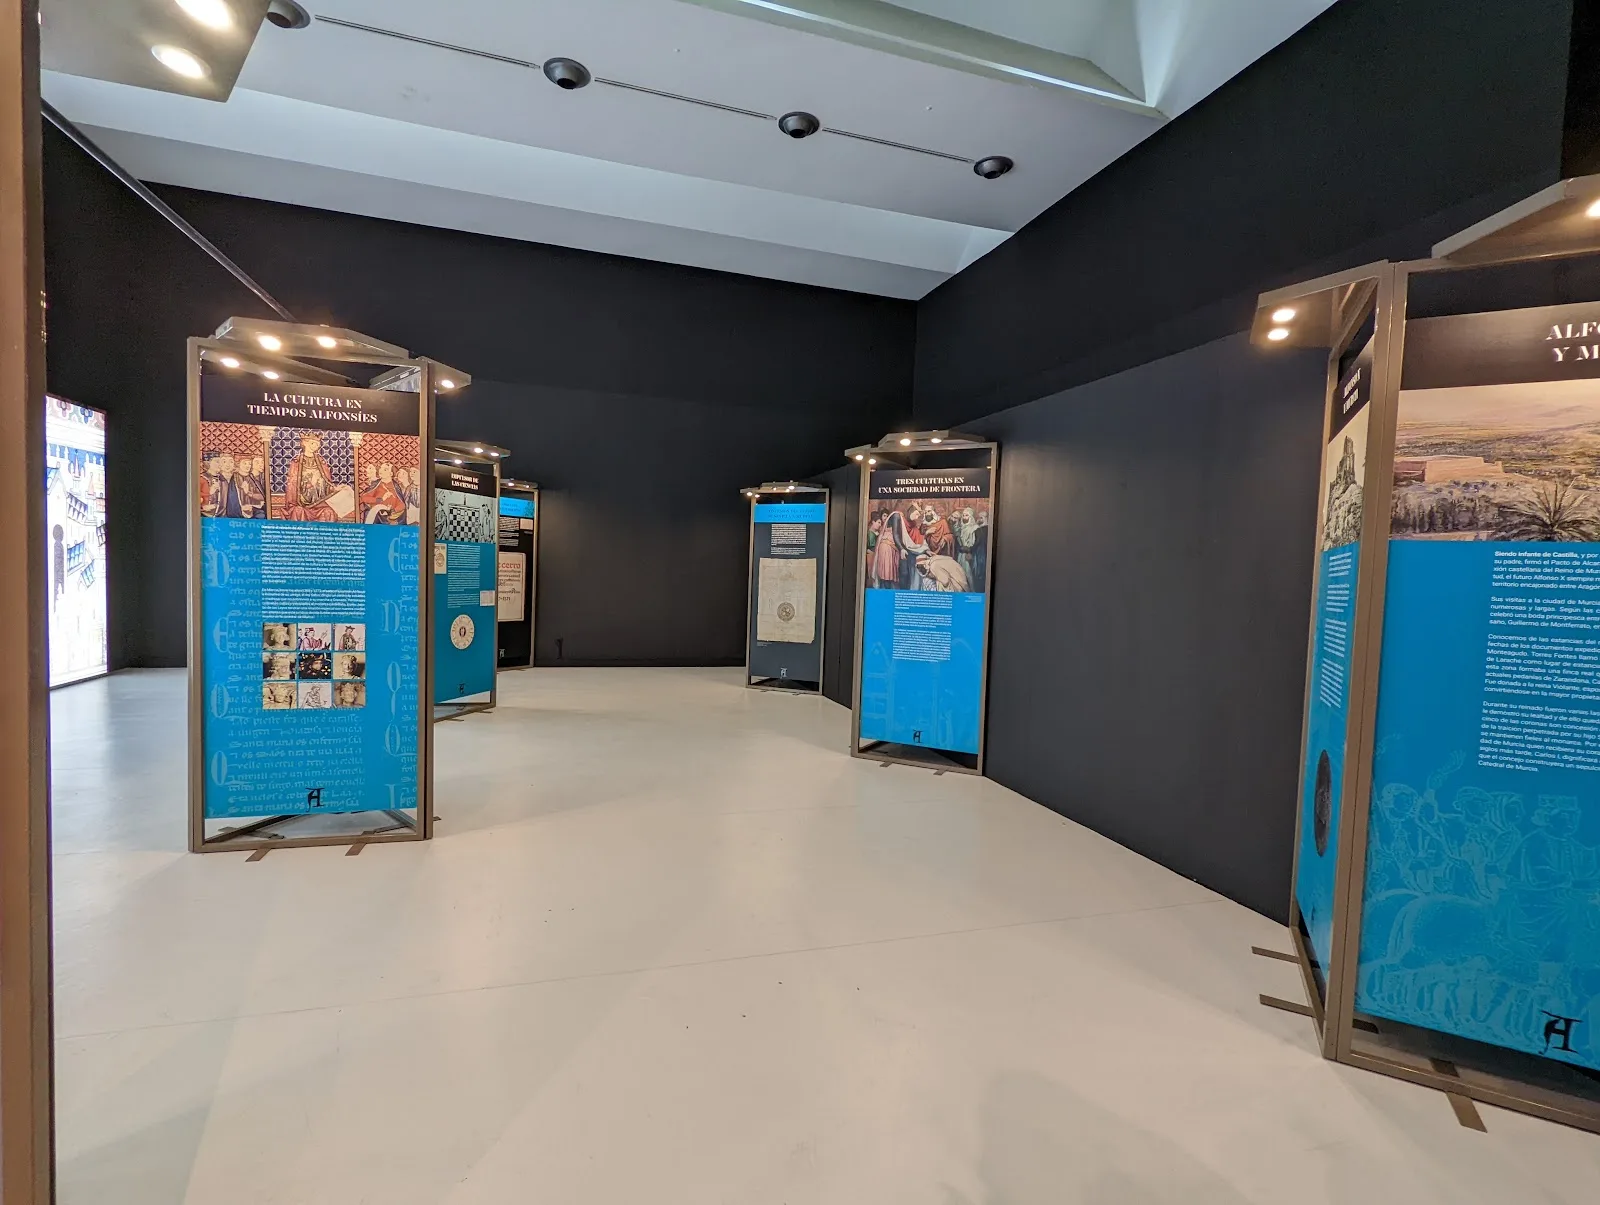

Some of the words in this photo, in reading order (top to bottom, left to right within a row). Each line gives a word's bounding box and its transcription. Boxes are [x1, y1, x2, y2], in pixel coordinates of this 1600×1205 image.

[1545, 322, 1600, 340] ALF
[1553, 347, 1570, 362] Y
[264, 392, 280, 402] LA
[284, 394, 342, 407] CULTURA
[346, 399, 362, 409] EN
[247, 404, 306, 418] TIEMPOS
[309, 409, 377, 422] ALFONSÍES
[1525, 758, 1564, 767] construyera
